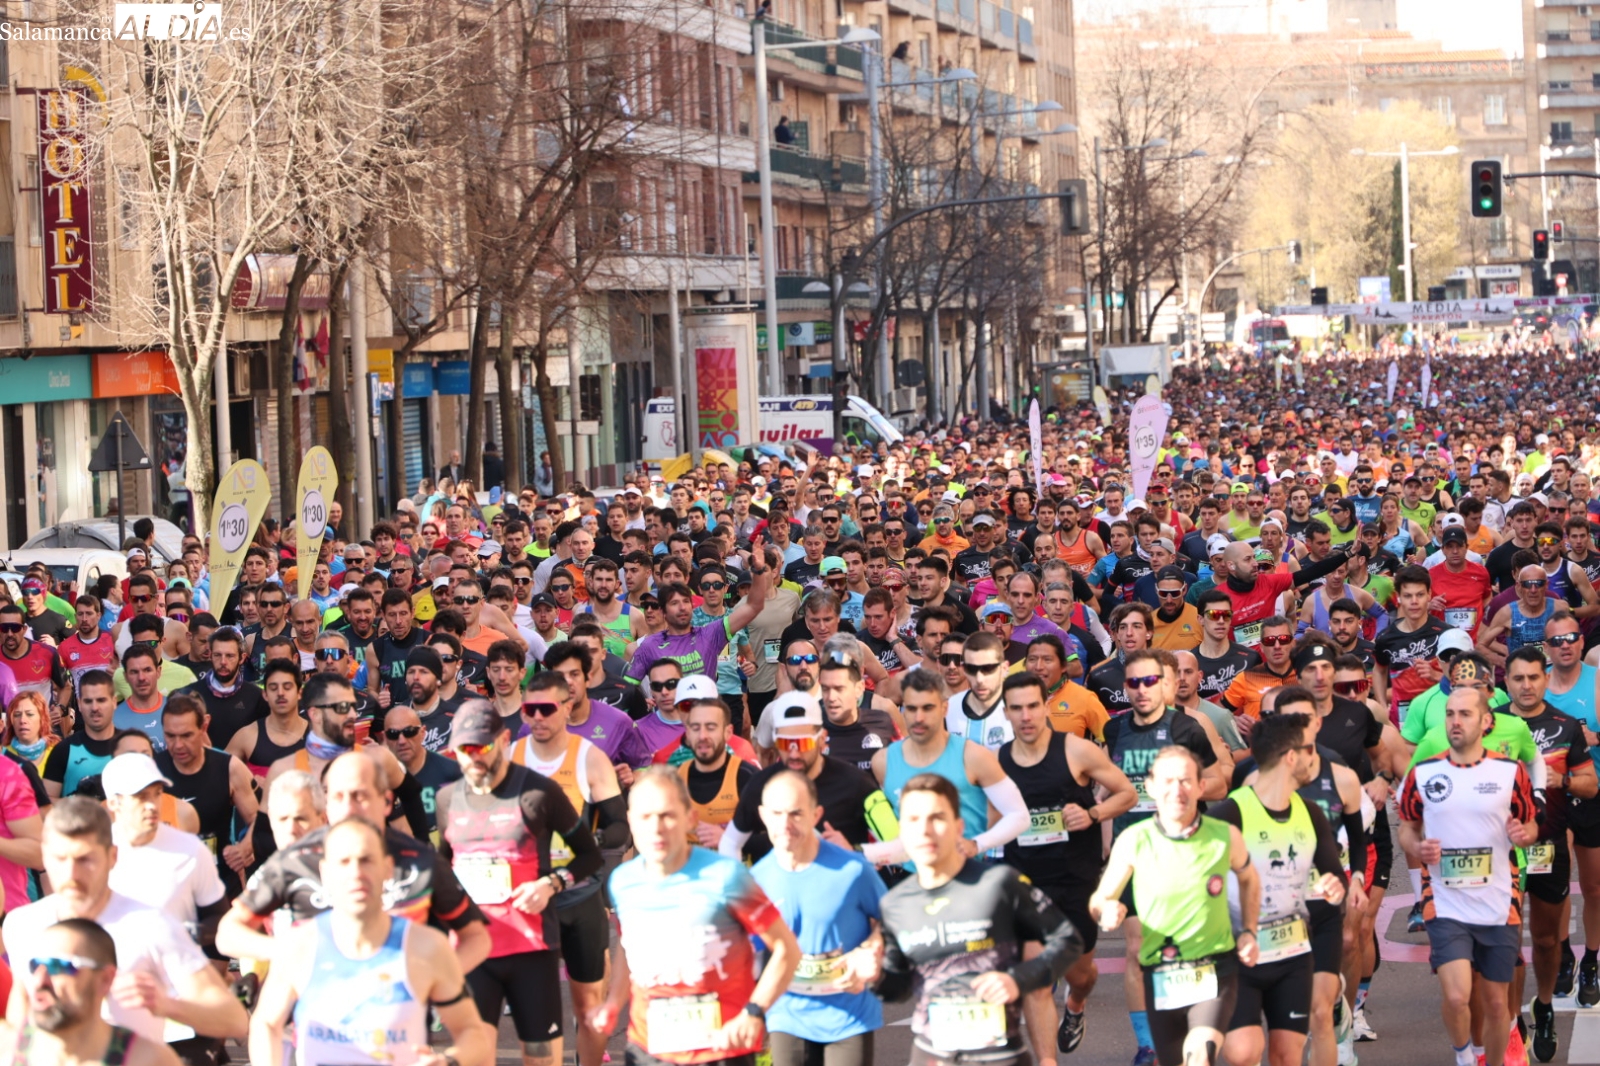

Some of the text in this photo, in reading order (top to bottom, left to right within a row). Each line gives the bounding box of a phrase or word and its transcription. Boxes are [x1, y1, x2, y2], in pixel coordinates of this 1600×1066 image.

[44, 90, 86, 312] HOTEL
[1412, 302, 1462, 313] MEDIA
[303, 504, 323, 524] 1h30
[220, 518, 245, 538] 1h30
[1453, 611, 1469, 620] 435
[1242, 626, 1259, 635] 989
[1031, 815, 1056, 827] 926
[1450, 857, 1483, 869] 1017
[1270, 925, 1293, 941] 281
